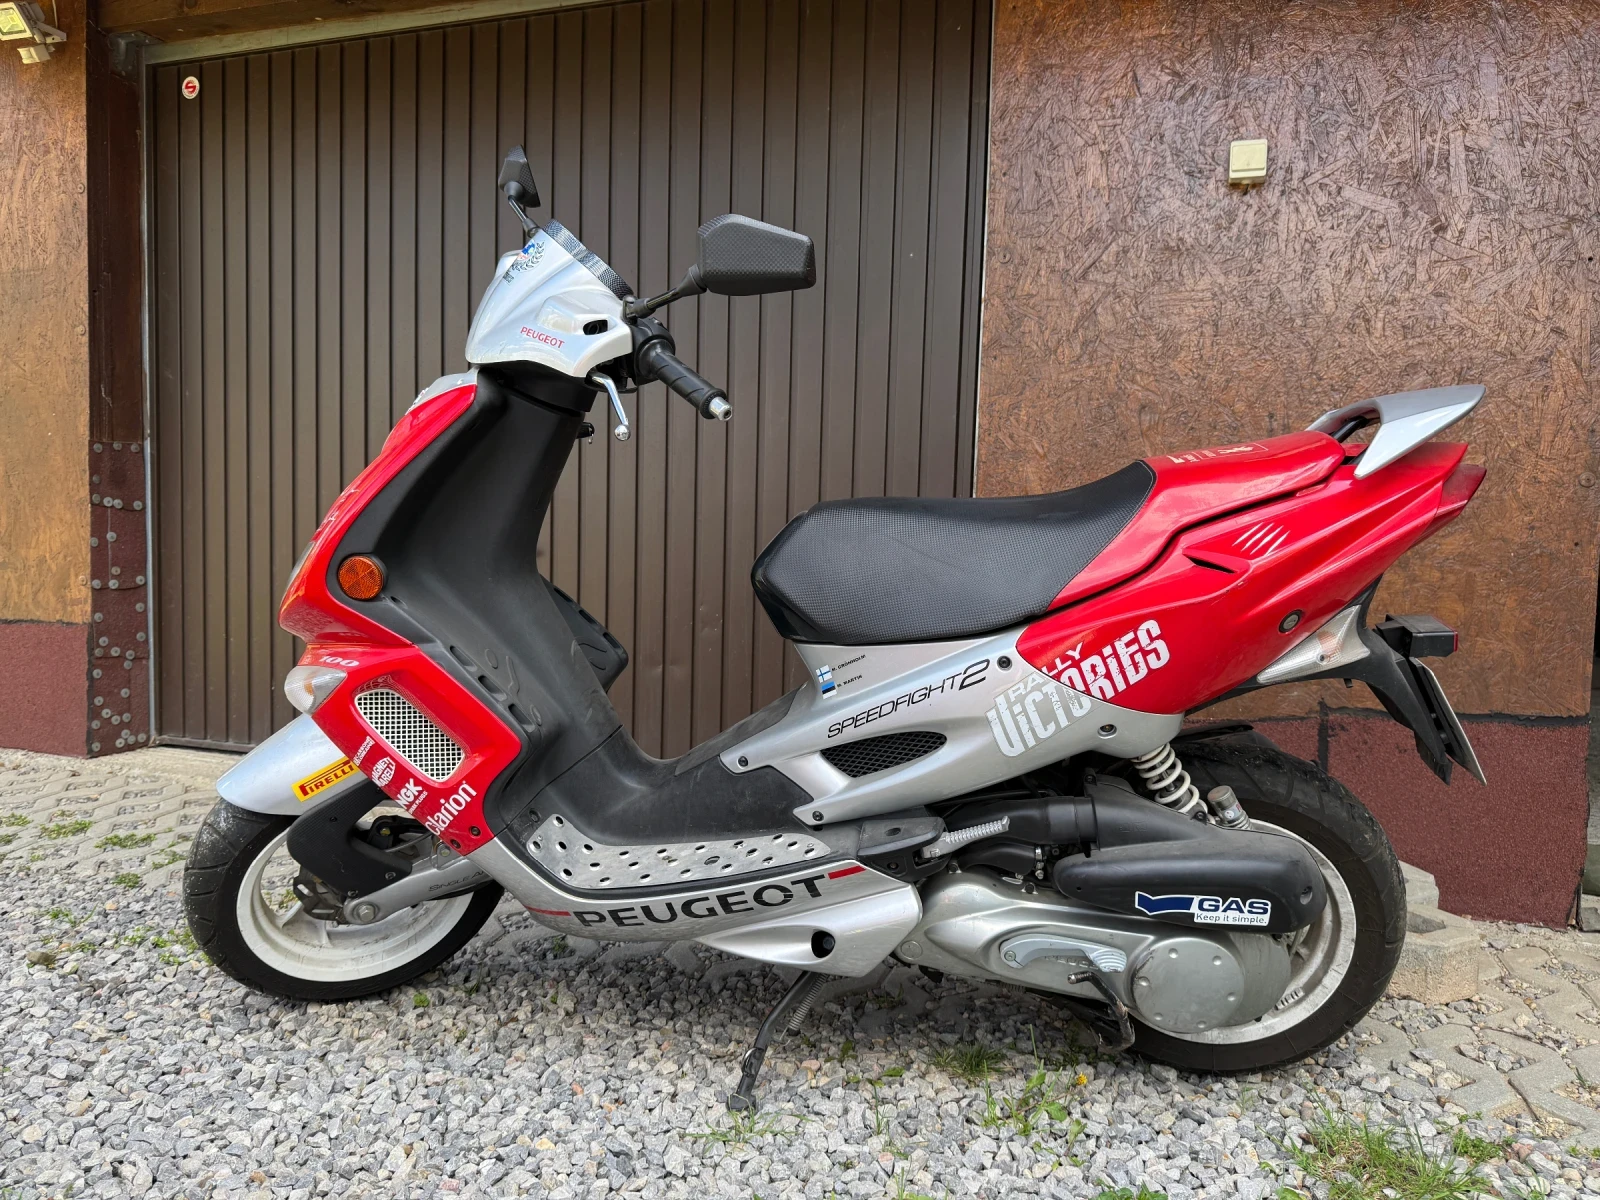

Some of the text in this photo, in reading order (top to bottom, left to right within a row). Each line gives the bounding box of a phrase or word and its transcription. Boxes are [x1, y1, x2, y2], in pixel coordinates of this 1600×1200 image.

[520, 326, 565, 348] PEUGEOT
[319, 656, 359, 667] 100
[1008, 642, 1083, 702] RALLY
[298, 759, 355, 797] PIRELLI
[395, 777, 423, 810] NGK
[573, 875, 826, 927] PEUGEOT
[1198, 898, 1269, 915] GAS
[1196, 912, 1267, 924] Keep it simple.
